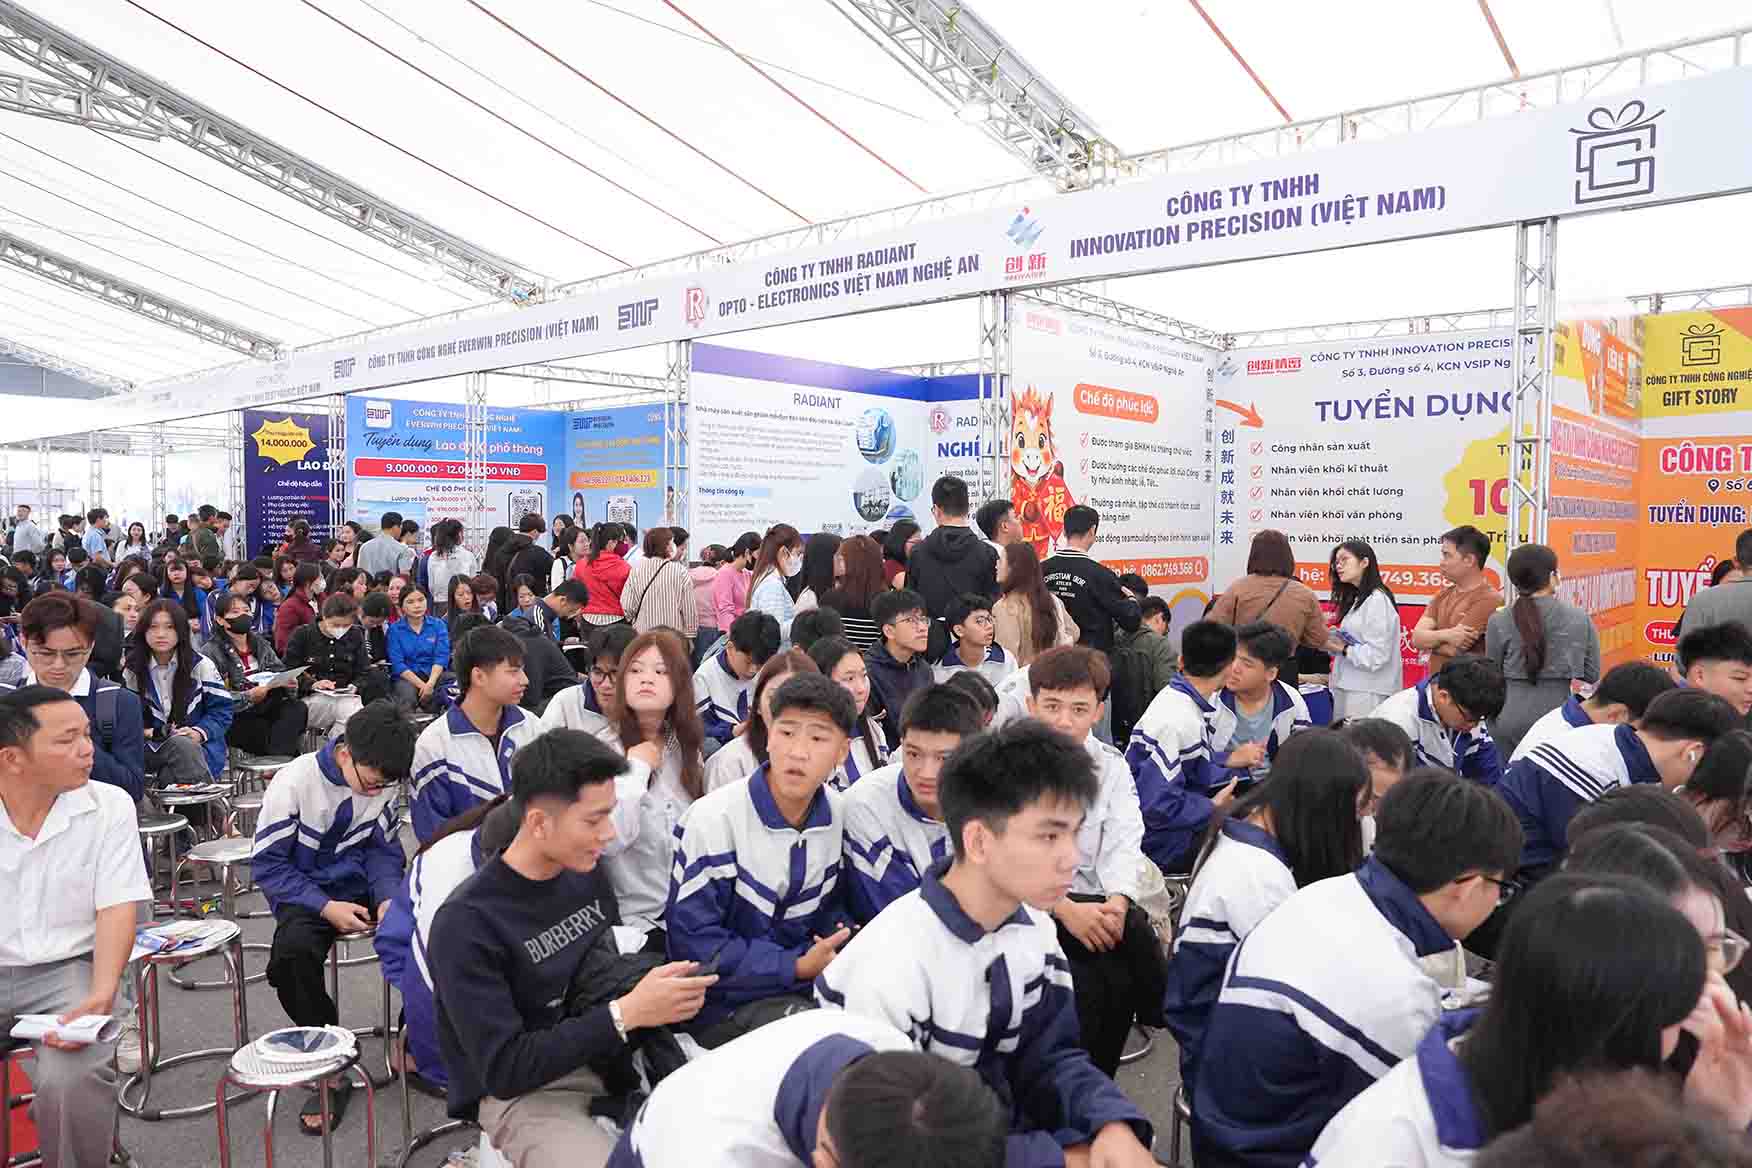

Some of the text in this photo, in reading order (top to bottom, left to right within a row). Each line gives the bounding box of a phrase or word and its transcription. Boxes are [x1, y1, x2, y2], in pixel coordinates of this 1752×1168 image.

[1167, 173, 1319, 217] CÔNG TY TNHH
[1070, 186, 1445, 258] INNOVATION PRECISION (VIỆT NAM)
[765, 243, 917, 288] CÔNG TY TNHH RADIANT
[719, 254, 980, 318] OPTO ELECTRONICS VIỆT NAM NGHỆ AN
[368, 315, 599, 369] CÔNG TY TNHH CÔNG NGHỆ EVERWIN PRECISION (VIỆT NAM)
[1310, 349, 1342, 363] CÔNG
[1343, 350, 1356, 361] TY
[1359, 347, 1389, 360] TNHH
[1392, 341, 1465, 357] INNOVATION
[1369, 364, 1405, 378] Đường
[1438, 360, 1461, 371] KCN
[1464, 358, 1491, 370] VSIP
[1646, 374, 1667, 386] CÔNG
[1669, 375, 1678, 384] TY
[1680, 373, 1701, 384] TNHH
[1703, 370, 1725, 382] CÔNG
[793, 392, 841, 409] RADIANT
[1315, 388, 1415, 422] TUYỂN
[1663, 388, 1738, 407] GIFT STORY
[261, 438, 307, 448] 14.000.000
[363, 432, 543, 457] Tuyển dụng Lao phổ thông
[1271, 440, 1371, 454] Công nhân sản xuất
[297, 461, 320, 470] LAO
[1661, 441, 1733, 473] CÔNG
[386, 463, 438, 474] 9.000.000
[499, 466, 521, 476] VNĐ
[1271, 464, 1298, 475] Nhân
[1299, 463, 1319, 475] viên
[1322, 462, 1346, 474] khối
[1360, 463, 1389, 475] thuật
[1220, 428, 1235, 545] 创新成就未来
[1270, 485, 1404, 499] Nhân viên khối chất lượng
[1726, 478, 1744, 490] Số
[1270, 508, 1403, 523] Nhân viên khối văn phòng
[1649, 498, 1695, 523] TUYỂN
[1700, 506, 1746, 527] DỤNG:
[1297, 532, 1318, 544] viên
[1320, 532, 1345, 544] khối
[1373, 532, 1398, 545] triển
[1401, 534, 1421, 545] sản
[1300, 567, 1324, 583] hệ:
[524, 899, 607, 964] BURBERRY
